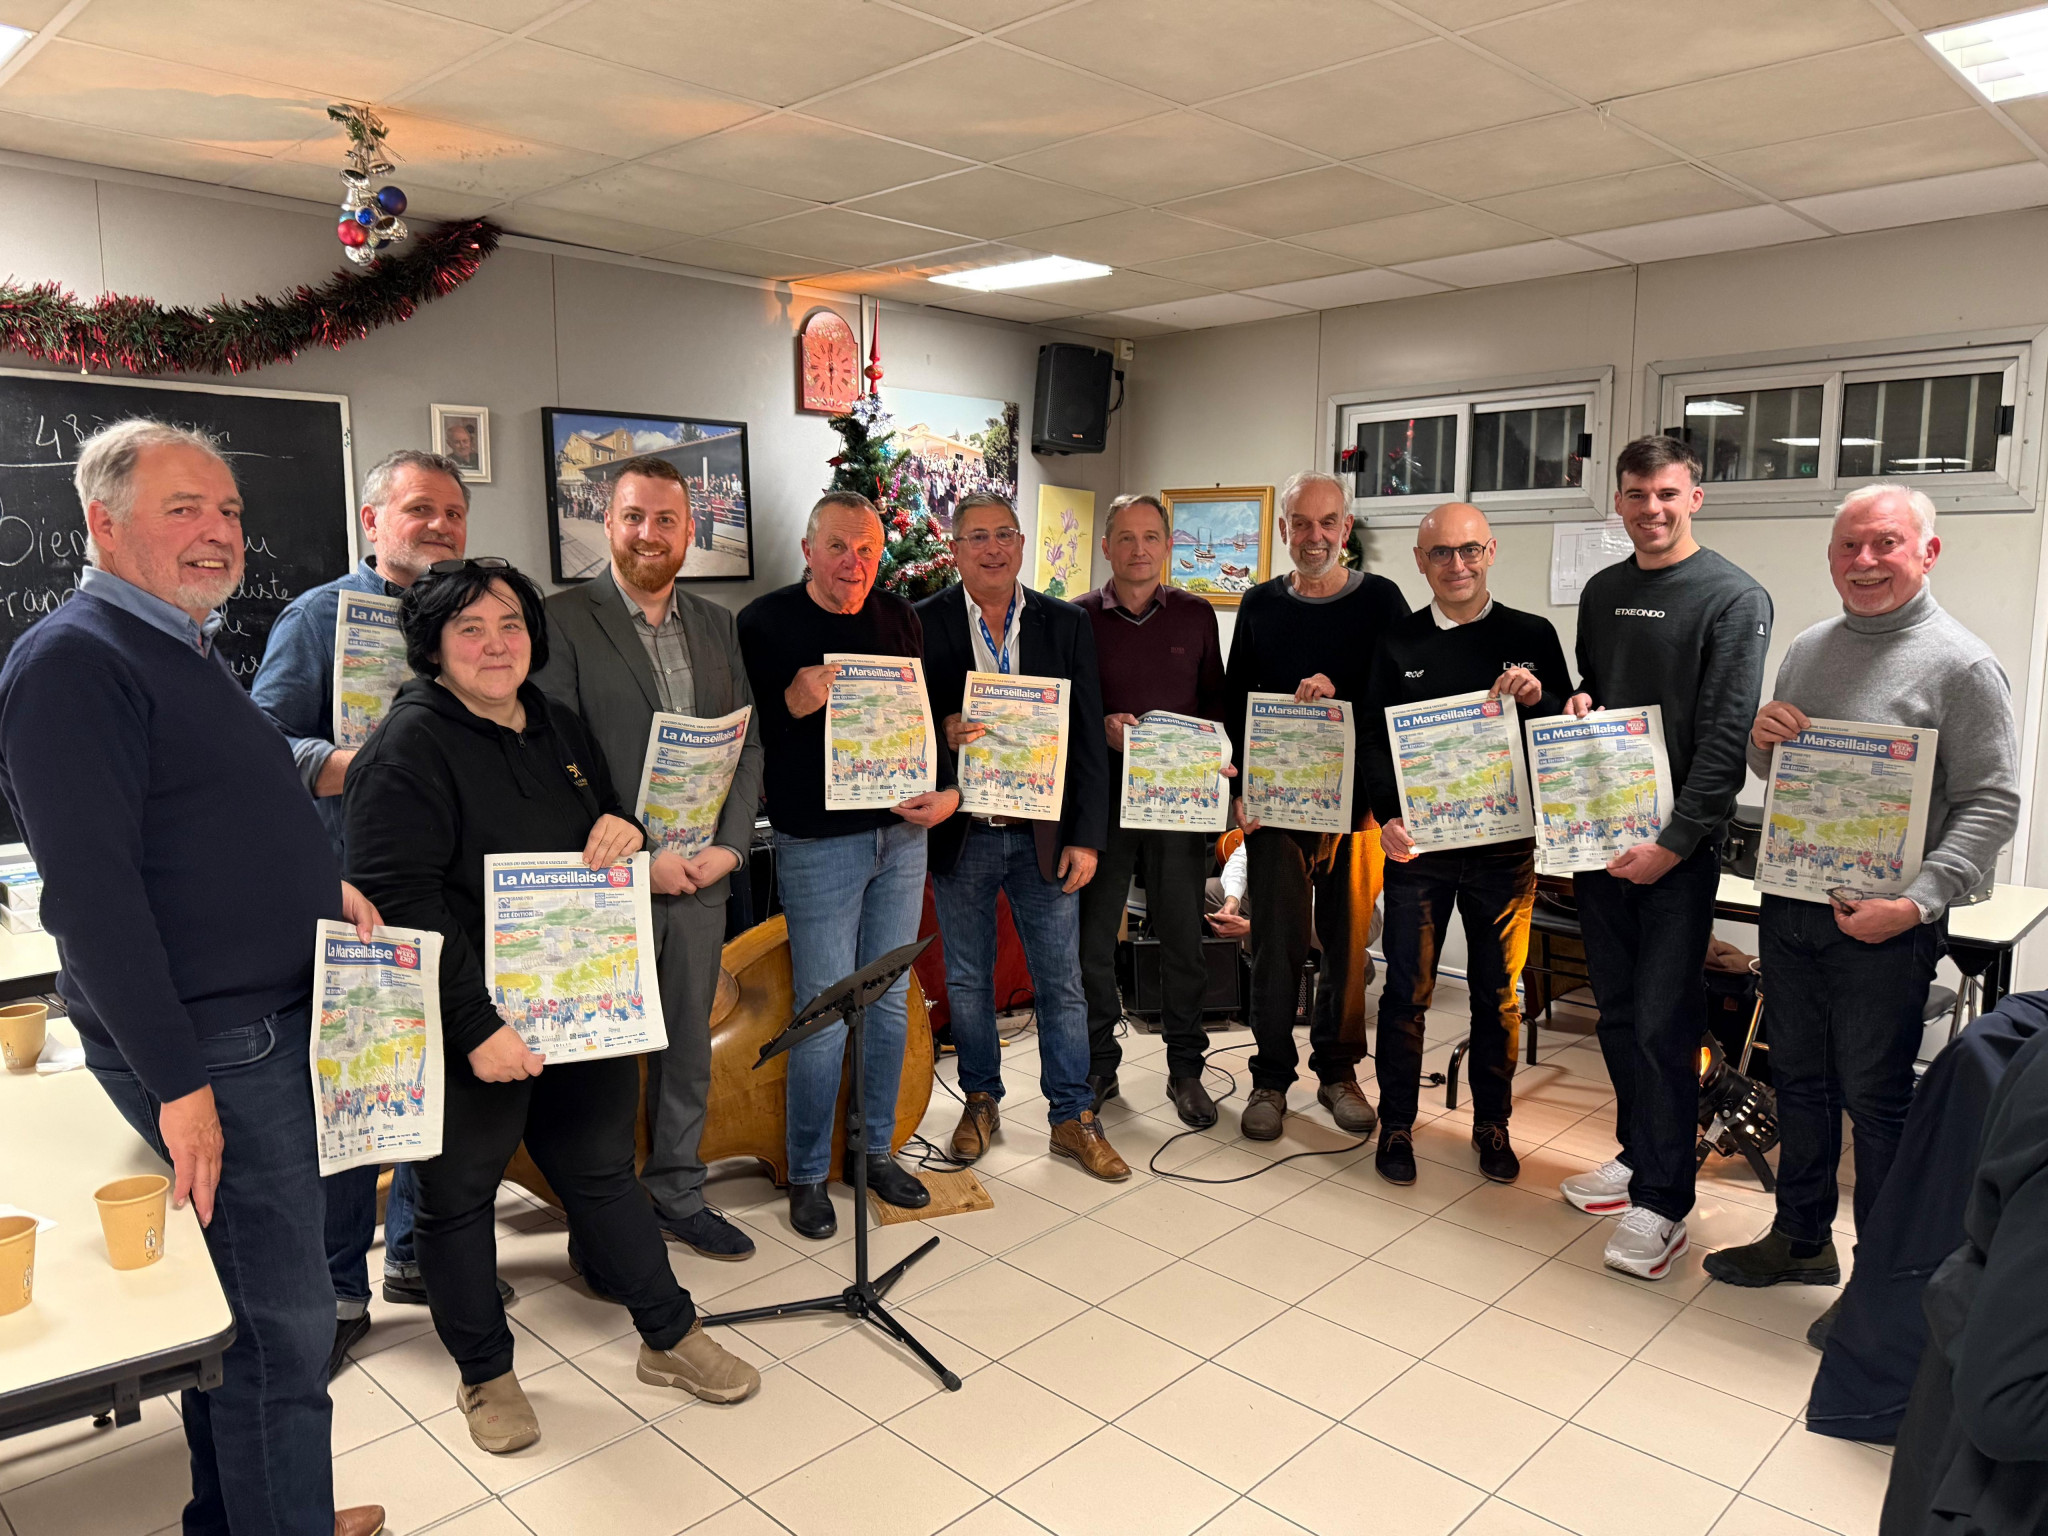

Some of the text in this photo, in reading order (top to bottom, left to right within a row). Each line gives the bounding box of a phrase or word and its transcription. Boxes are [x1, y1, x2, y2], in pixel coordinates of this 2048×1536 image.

[351, 607, 367, 620] La
[1615, 608, 1666, 618] ETXEONDO
[848, 667, 901, 678] Marseillaise
[973, 684, 1041, 699] La Marseillaise
[1255, 704, 1266, 713] La
[1268, 705, 1327, 717] Marseillaise
[1397, 718, 1411, 728] La
[1413, 706, 1481, 726] Marseillaise
[662, 728, 736, 744] La Marseillaise
[1536, 724, 1625, 741] La Marseillaise
[1802, 733, 1888, 753] Marseillaise
[498, 871, 607, 886] La Marseillaise
[327, 942, 394, 960] La Marseillaise
